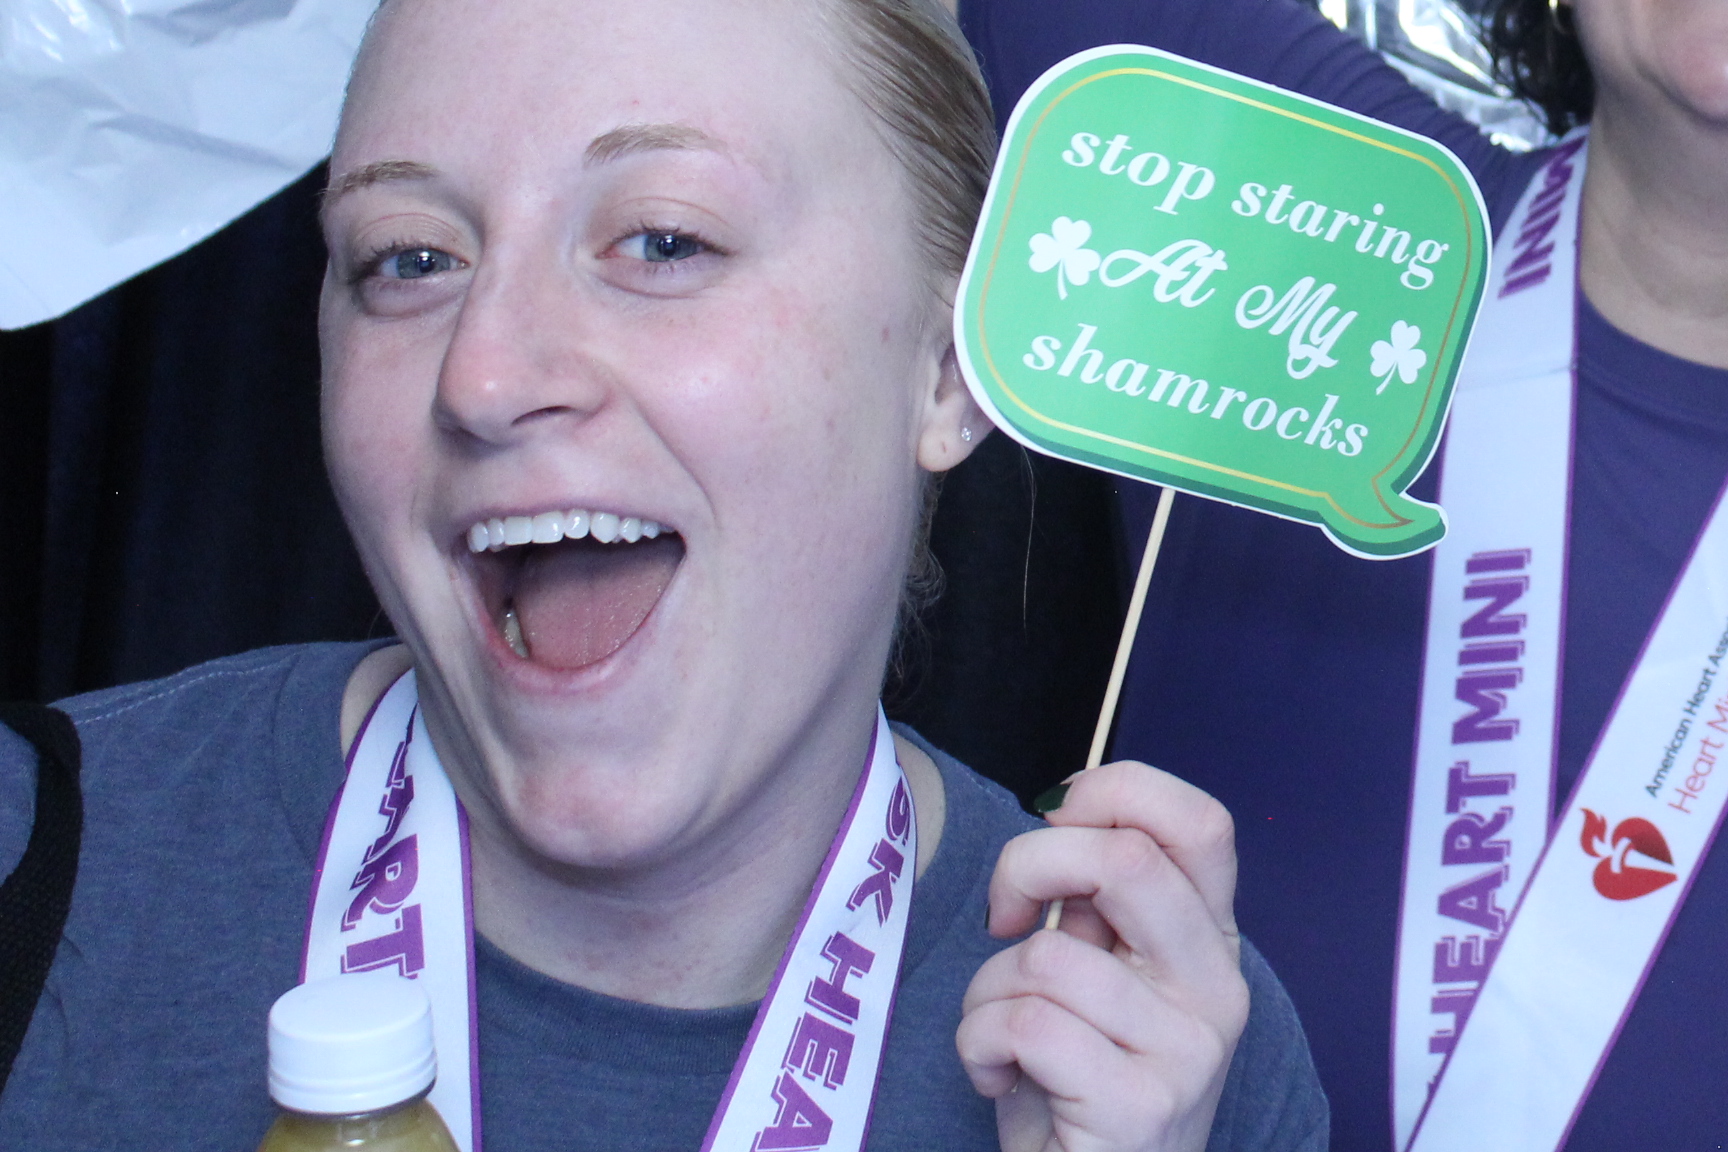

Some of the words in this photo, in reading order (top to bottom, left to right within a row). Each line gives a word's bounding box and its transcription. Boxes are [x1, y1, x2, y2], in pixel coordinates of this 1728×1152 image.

[1061, 131, 1216, 215] stop
[1231, 183, 1450, 290] staring
[1099, 239, 1228, 308] At
[1235, 276, 1358, 379] My
[1022, 323, 1369, 458] shamrocks
[1451, 547, 1532, 745] MINI
[1645, 717, 1692, 799] American
[1682, 667, 1717, 718] Heart
[1668, 735, 1725, 815] Heart
[341, 741, 424, 981] ART
[846, 776, 910, 928] 5K
[750, 931, 876, 1152] HEA
